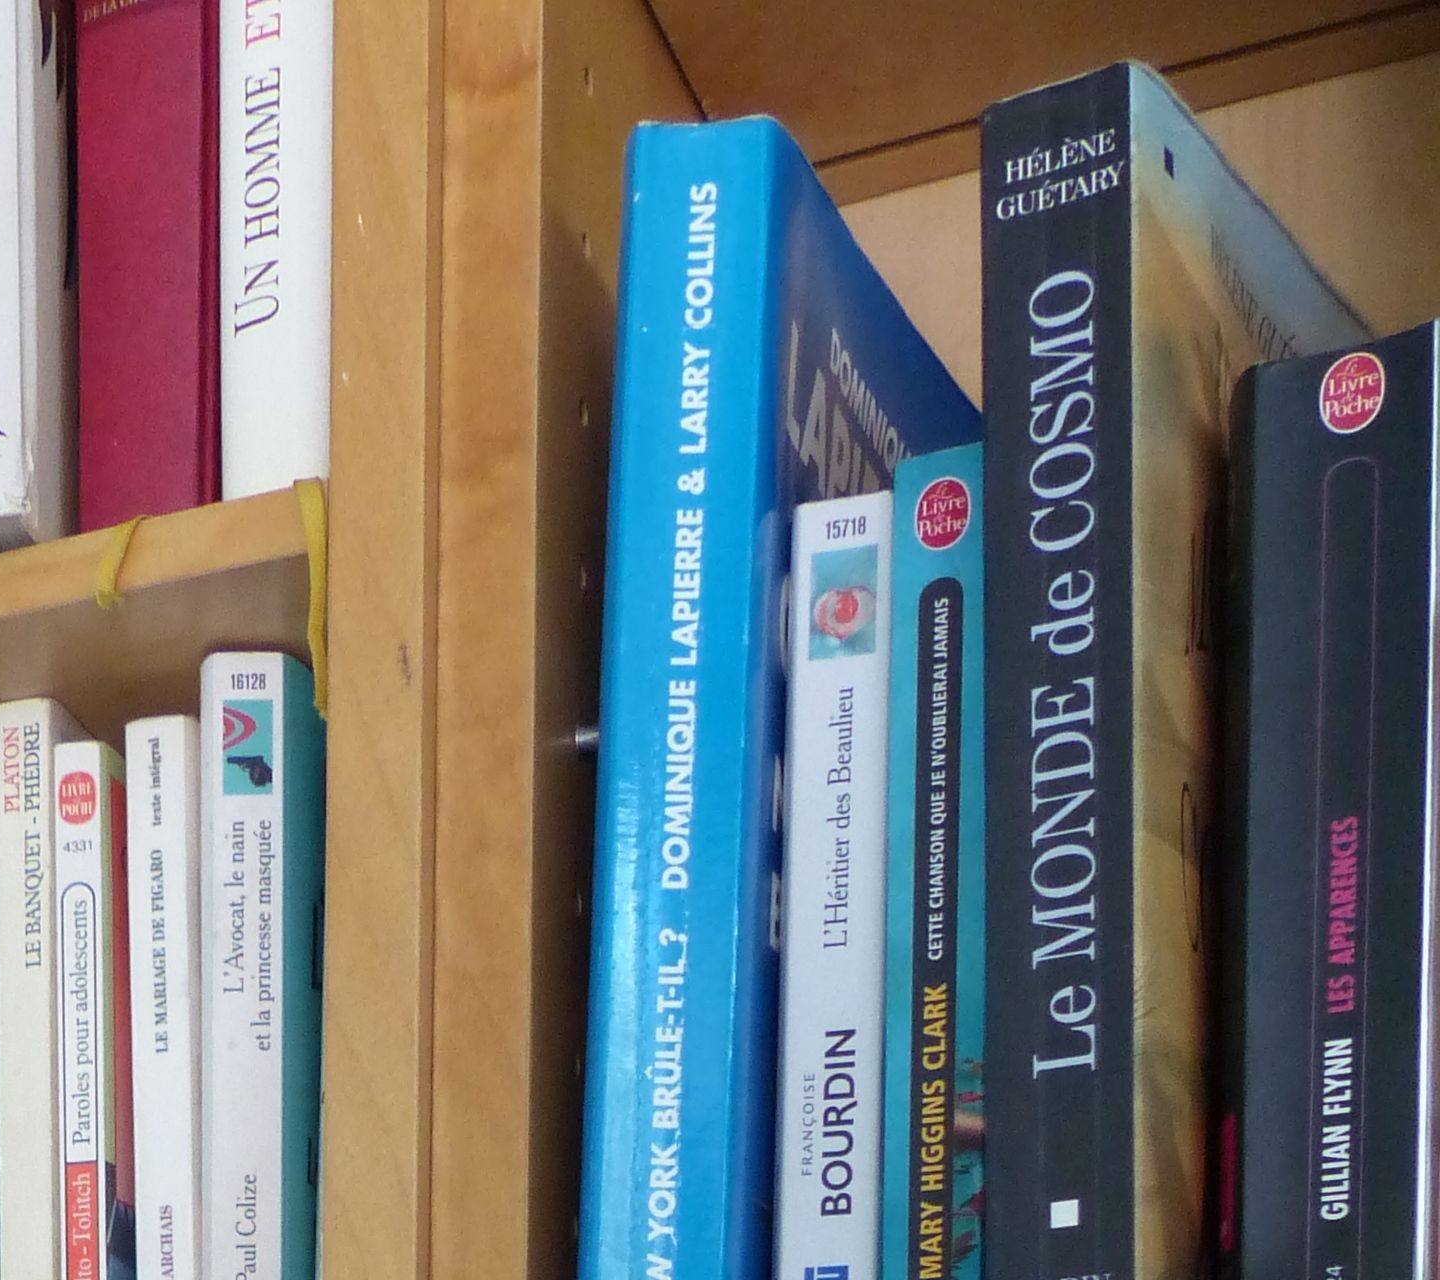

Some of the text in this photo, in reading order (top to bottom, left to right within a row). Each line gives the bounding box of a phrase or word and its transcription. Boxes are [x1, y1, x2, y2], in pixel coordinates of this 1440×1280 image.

[233, 65, 281, 338] UN HOMME
[1004, 128, 1117, 182] HÉLÈNE
[661, 181, 718, 890] DOMINIQUE LAPIERRE & LARRY COLLINS
[2, 725, 21, 813] PLATON
[1028, 270, 1098, 1079] Le MONDE de COSMO
[822, 687, 855, 949] L'Héritier des Beaulieu
[69, 899, 95, 1144] Paroles pour adolescents
[644, 958, 688, 1130] BRÛLE-T-IL
[820, 1028, 858, 1216] BOURDIN
[918, 982, 948, 1280] MARY HIGGINS CLARK
[1319, 815, 1359, 1220] GILLIAN FLYNN LES APPARENCES
[235, 1173, 258, 1237] Colize
[647, 1142, 680, 1242] YORK
